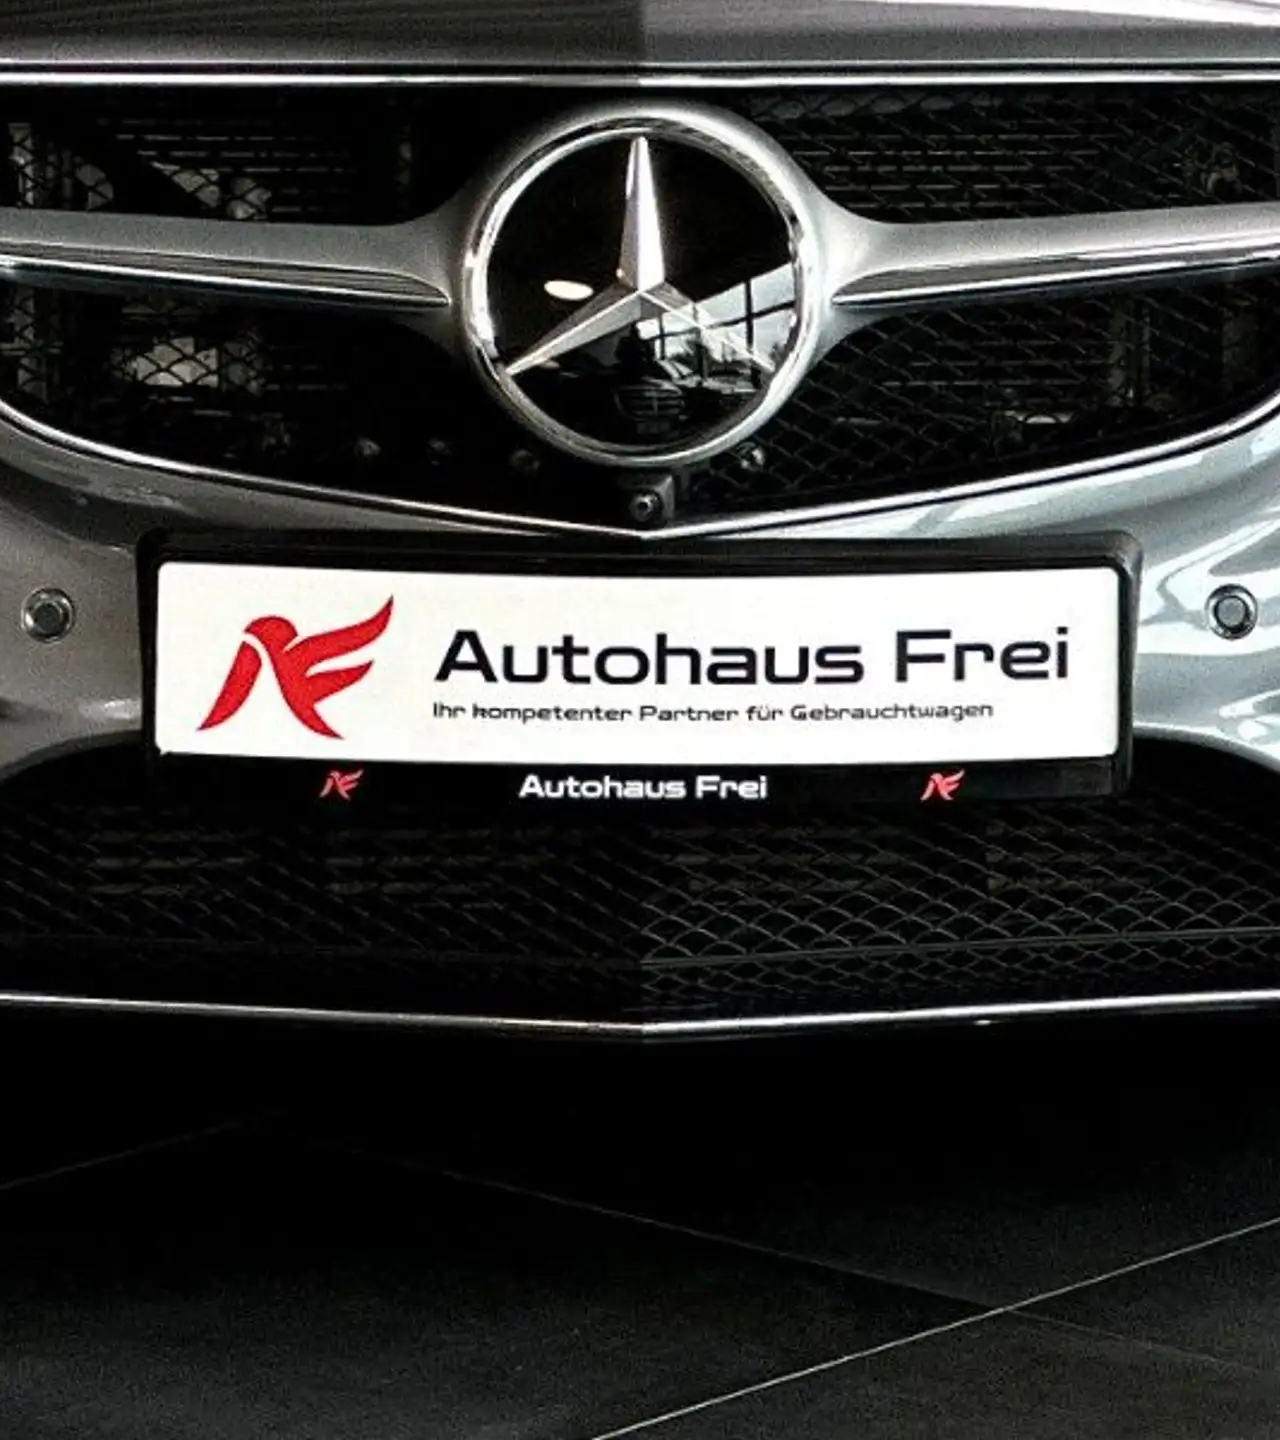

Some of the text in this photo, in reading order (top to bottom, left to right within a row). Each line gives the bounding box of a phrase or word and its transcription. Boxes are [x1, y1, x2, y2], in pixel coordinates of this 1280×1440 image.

[434, 626, 1069, 685] Autohaus Frei
[433, 701, 993, 725] Ihr kompetenter Partner für Gebrauchtwagen
[519, 774, 768, 799] Autohaus Frei
